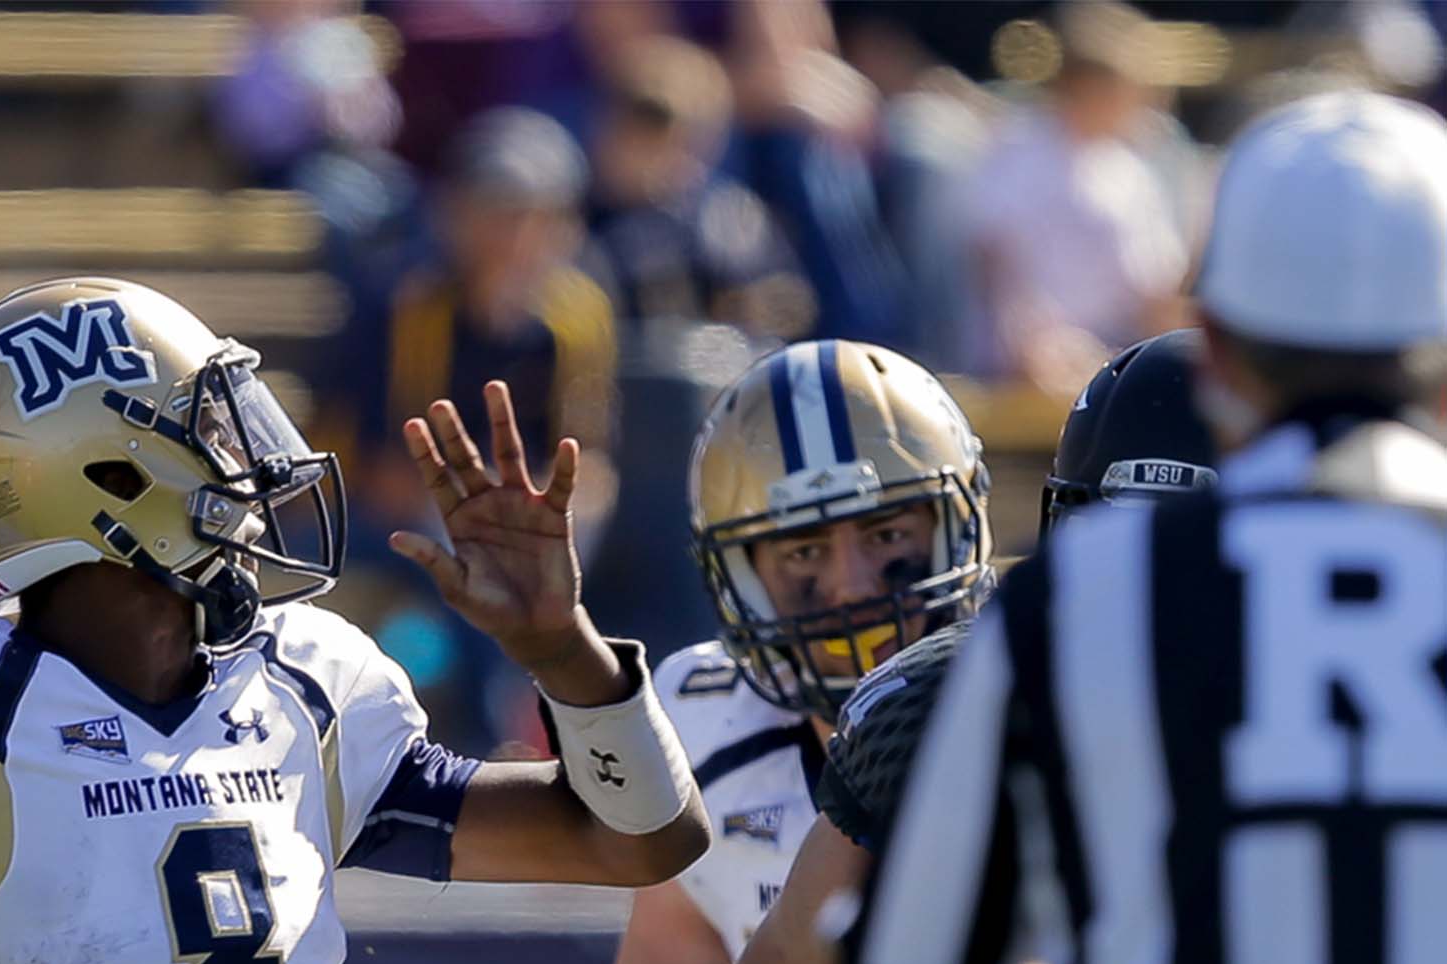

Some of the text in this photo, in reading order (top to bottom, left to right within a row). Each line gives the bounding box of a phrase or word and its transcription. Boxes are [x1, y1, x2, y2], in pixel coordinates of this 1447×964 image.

[1139, 463, 1183, 485] WSU
[1217, 500, 1447, 805] R
[84, 719, 122, 740] SKY
[81, 767, 285, 818] MONTANA STATE
